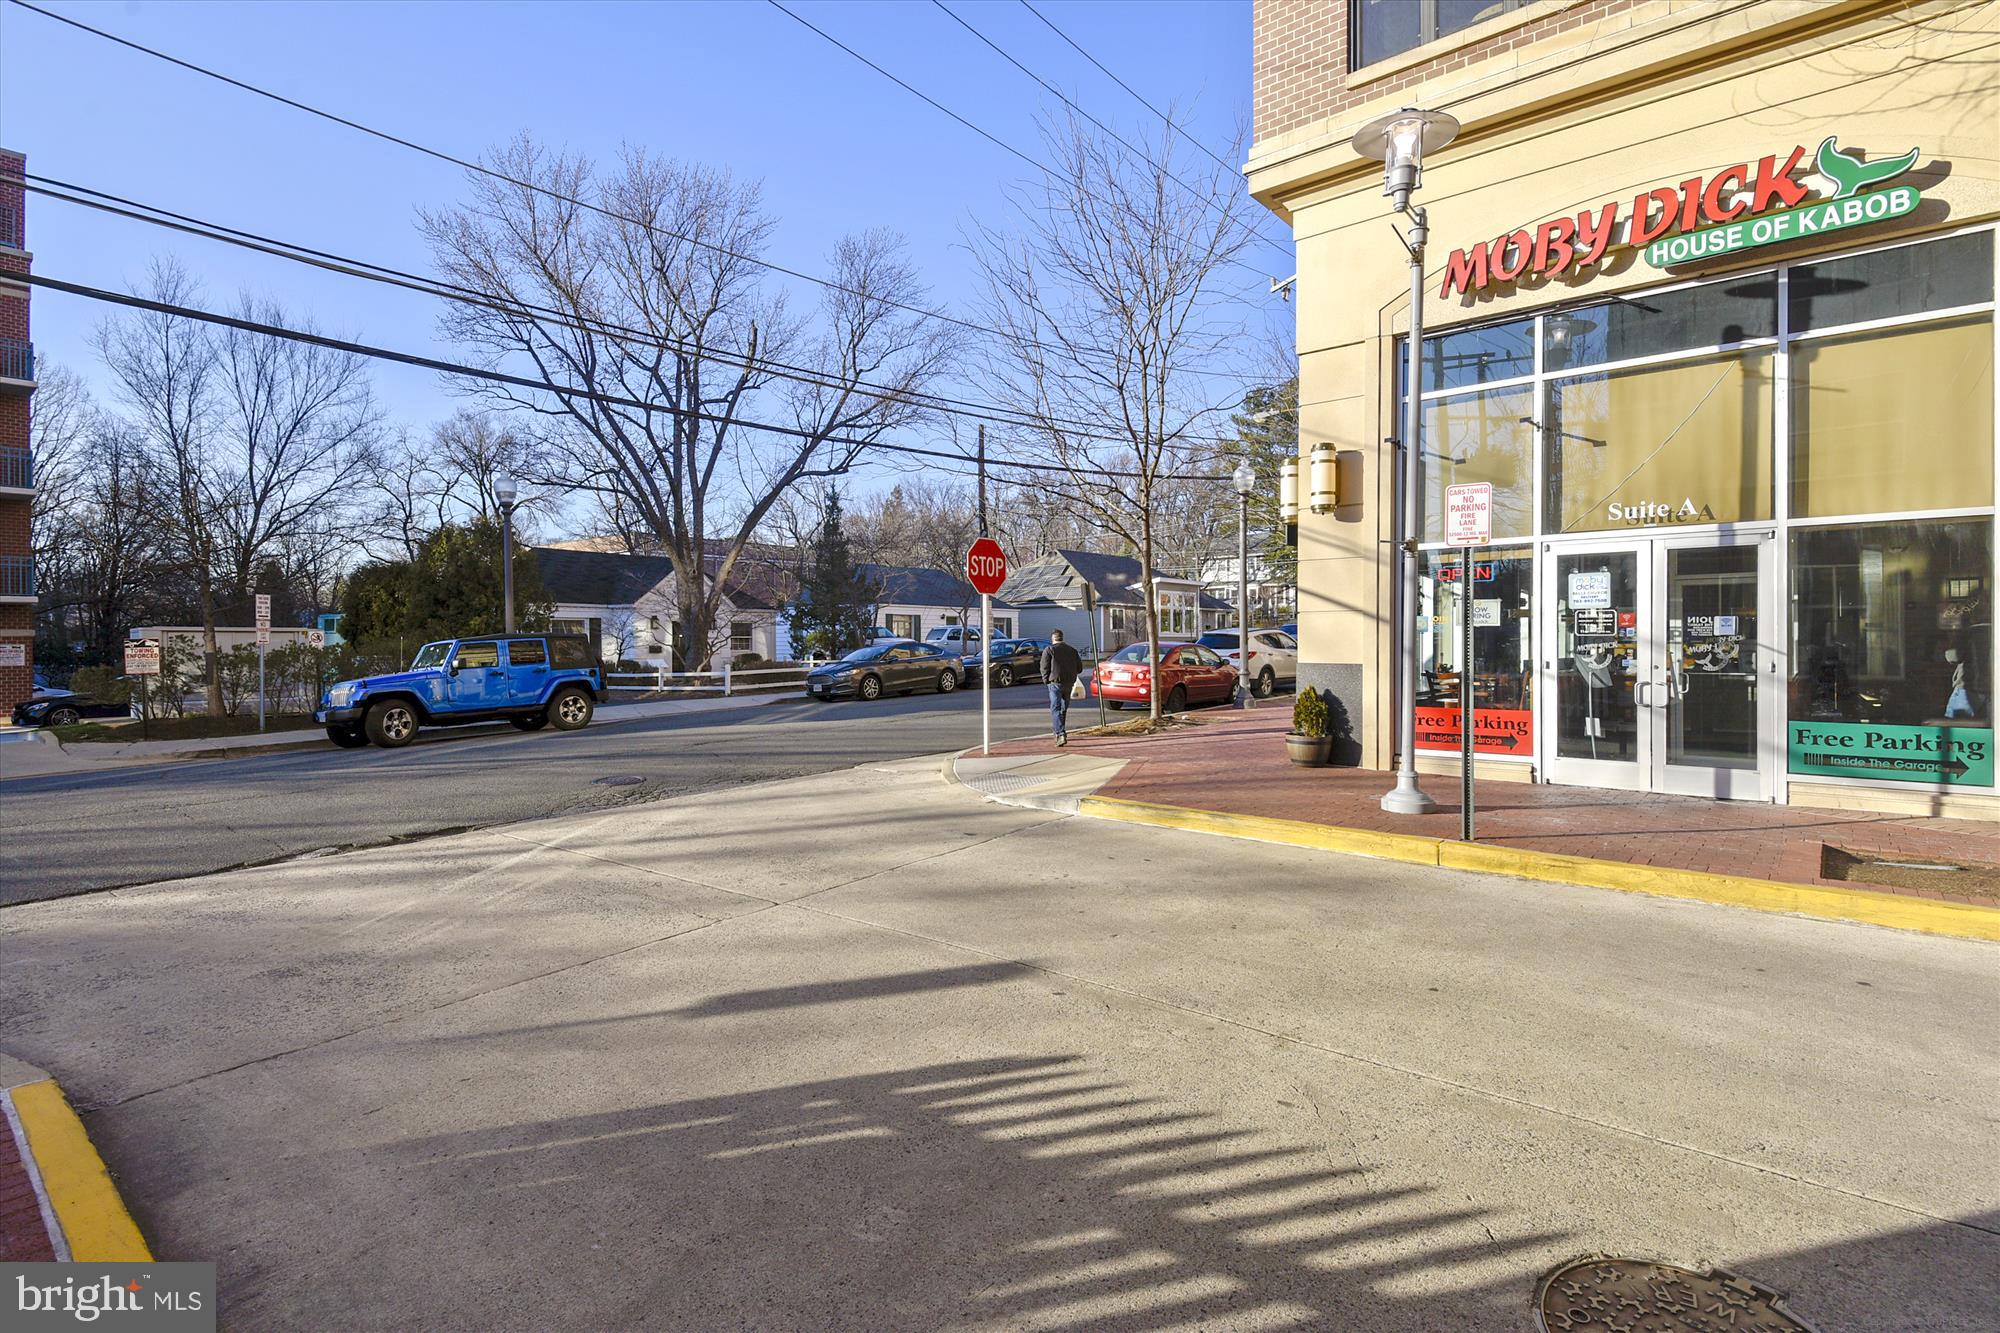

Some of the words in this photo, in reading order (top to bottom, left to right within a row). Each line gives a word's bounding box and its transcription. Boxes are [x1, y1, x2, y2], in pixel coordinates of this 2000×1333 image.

[1440, 201, 1618, 300] MOBY
[1629, 145, 1809, 246] DICK
[1652, 226, 1744, 264] HOUSE
[1751, 214, 1789, 242] OF
[1798, 189, 1911, 234] KABOB
[1451, 503, 1487, 512] PARKING
[1463, 495, 1475, 503] NO
[1608, 500, 1669, 520] Suite
[1678, 497, 1698, 515] A
[970, 555, 1004, 577] STOP
[1437, 566, 1491, 581] OPN
[1414, 713, 1445, 726] ree
[1452, 714, 1528, 736] Prking
[1795, 728, 1854, 748] Free
[1864, 732, 1985, 760] Parking
[1830, 756, 1865, 766] Inside
[1869, 758, 1891, 767] The
[1894, 760, 1950, 773] Garage
